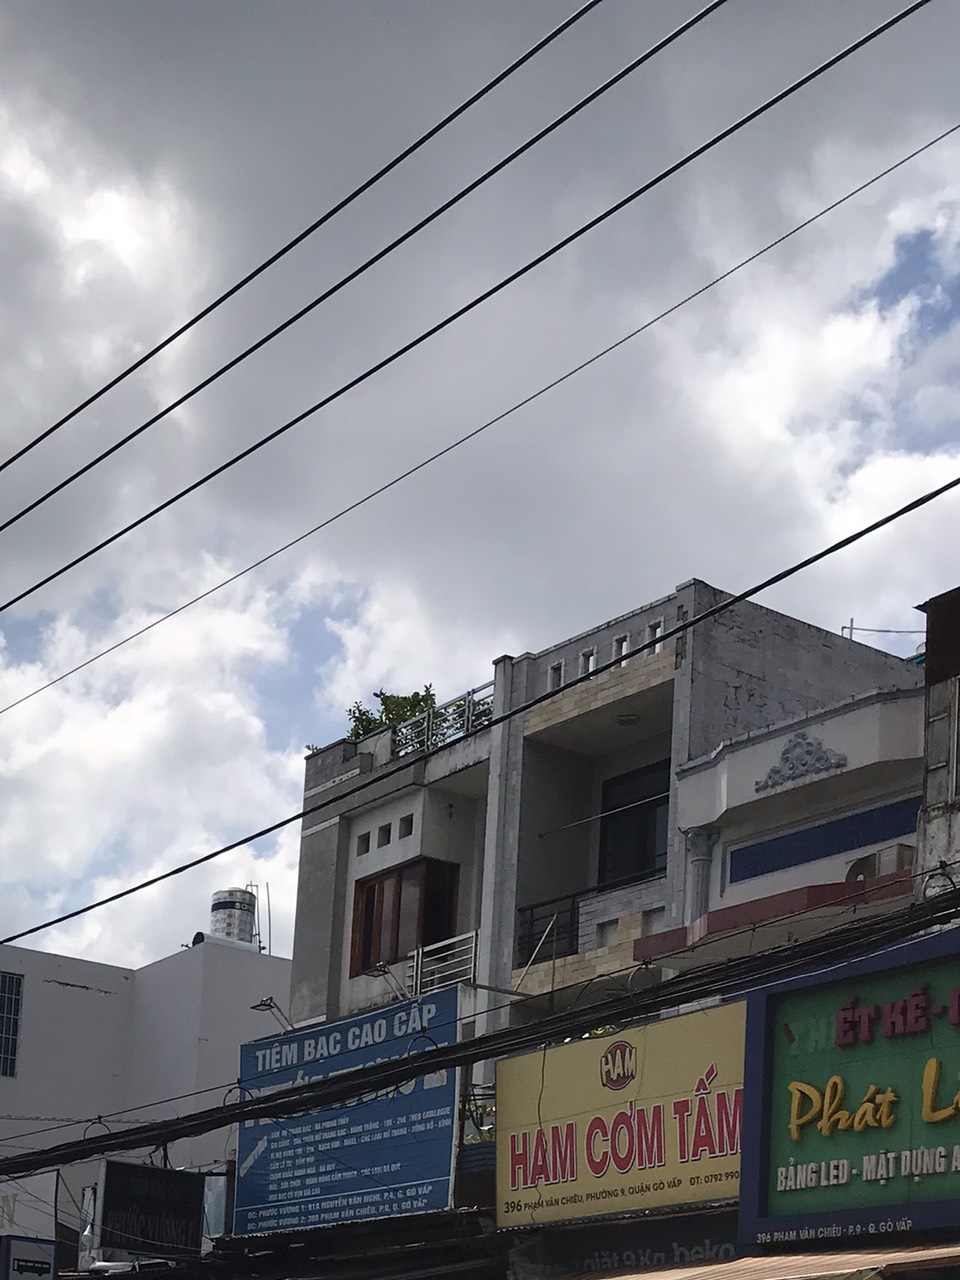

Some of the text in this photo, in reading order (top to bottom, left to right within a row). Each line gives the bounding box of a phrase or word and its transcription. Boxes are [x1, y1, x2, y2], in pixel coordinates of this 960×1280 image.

[256, 996, 437, 1072] TIỆM BẠC CAO CẤP
[601, 1047, 637, 1087] HAM
[510, 1063, 743, 1190] HAM CƠM TẤM
[787, 1074, 898, 1141] Phát
[504, 1200, 522, 1214] 396
[586, 1186, 620, 1201] PHƯỜNG
[628, 1182, 651, 1197] QUẬN
[652, 1181, 666, 1192] GÒ
[667, 1178, 683, 1190] VẤP
[689, 1175, 703, 1187] ĐT:
[704, 1172, 723, 1184] 0792
[724, 1170, 740, 1181] 990
[776, 1158, 819, 1192] BẢNG
[820, 1158, 851, 1188] LED
[863, 1149, 897, 1185] MẶT
[901, 1145, 947, 1182] DỰNG
[756, 1230, 771, 1244] 396
[799, 1225, 815, 1240] VĂN
[879, 1217, 894, 1233] GÒ
[896, 1215, 913, 1231] VẤP
